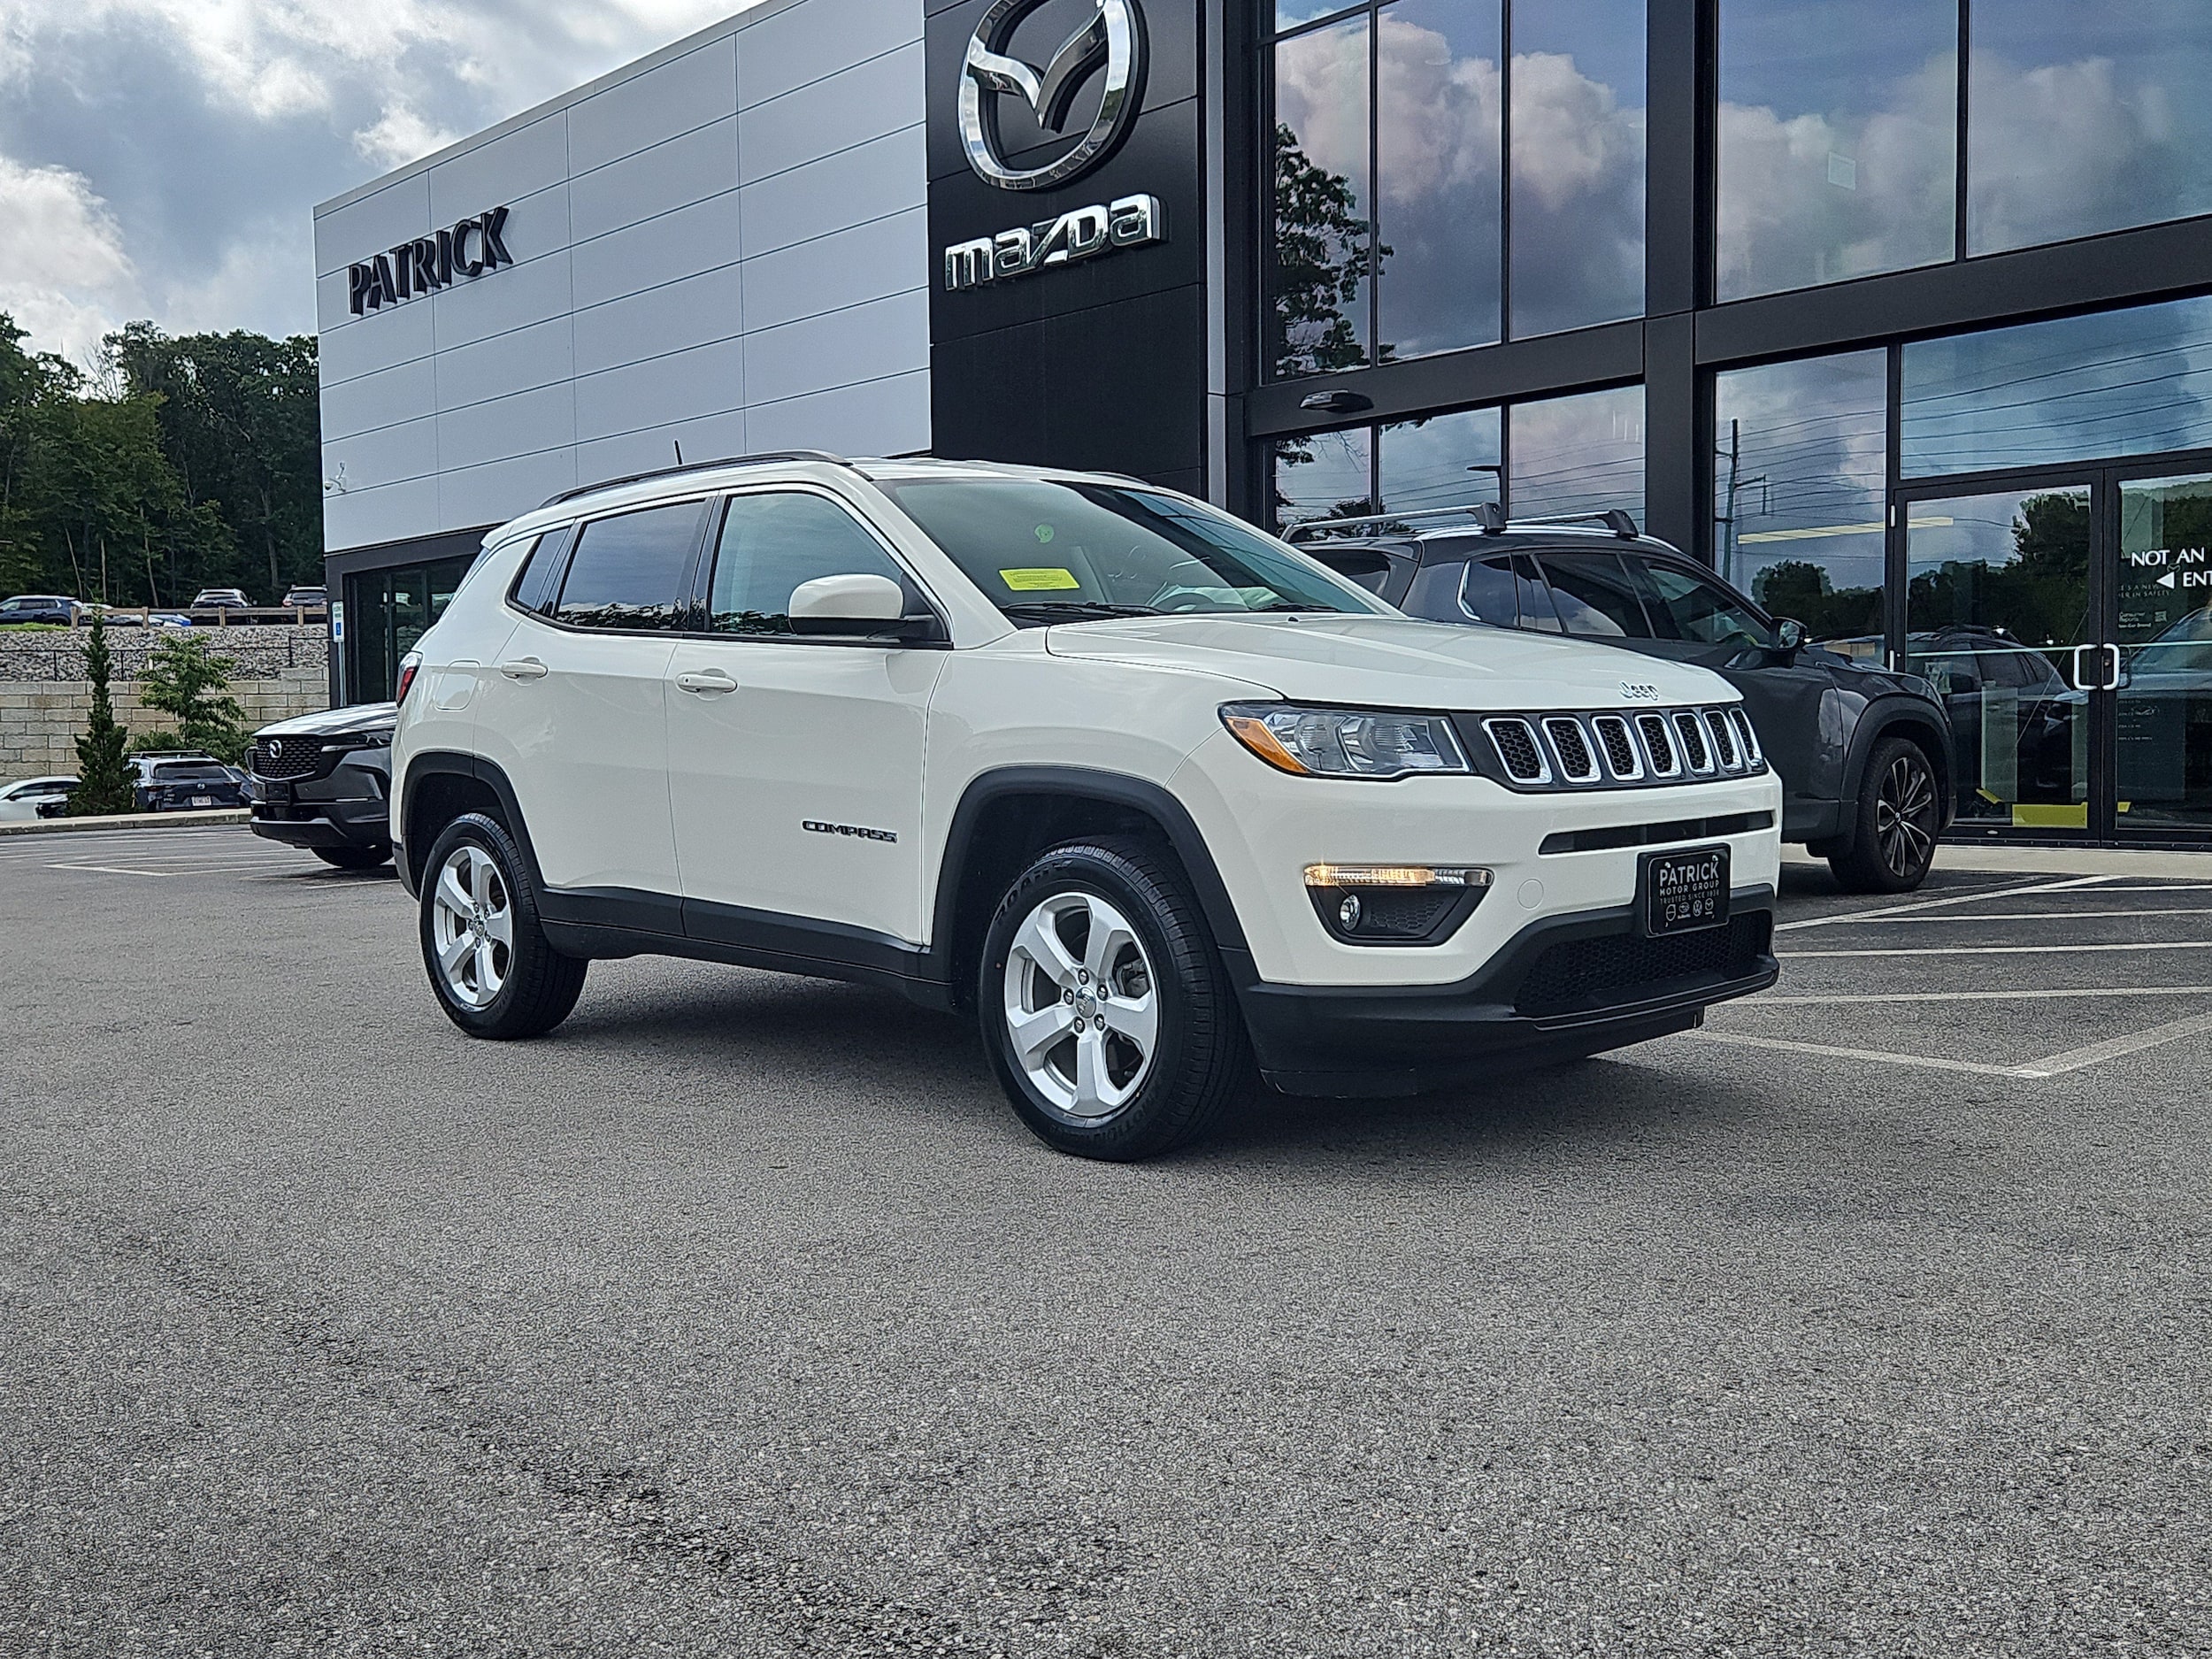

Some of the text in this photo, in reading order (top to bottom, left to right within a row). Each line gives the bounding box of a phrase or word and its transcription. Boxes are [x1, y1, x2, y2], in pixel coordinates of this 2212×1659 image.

[349, 206, 513, 316] PATRICK
[2131, 546, 2205, 567] NOT AN
[1619, 681, 1658, 701] Jeep
[802, 820, 897, 843] COMPASS
[1659, 862, 1718, 887] PATRICK
[1659, 879, 1719, 896] MOTOR GROUP
